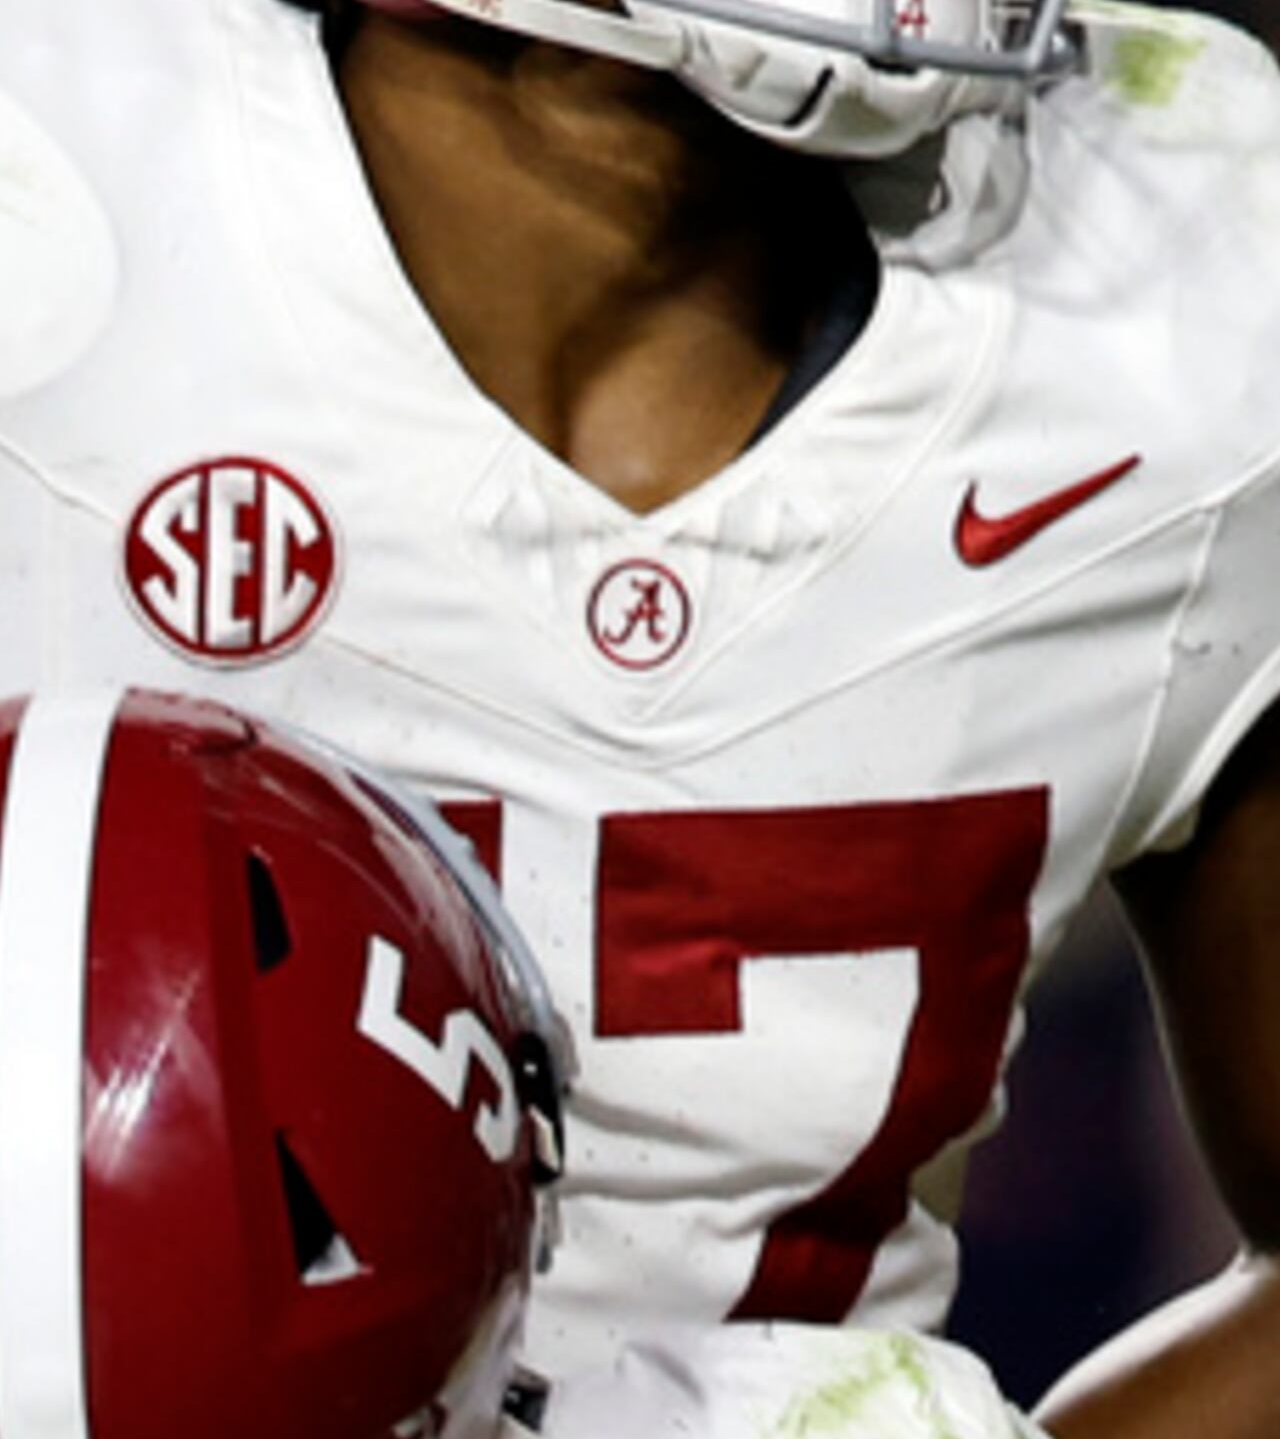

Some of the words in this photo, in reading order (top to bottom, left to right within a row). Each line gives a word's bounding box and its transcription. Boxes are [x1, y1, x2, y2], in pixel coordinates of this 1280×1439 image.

[138, 465, 323, 650] SEC
[604, 577, 666, 645] A
[356, 934, 520, 1163] 5
[436, 783, 1051, 1325] 7
